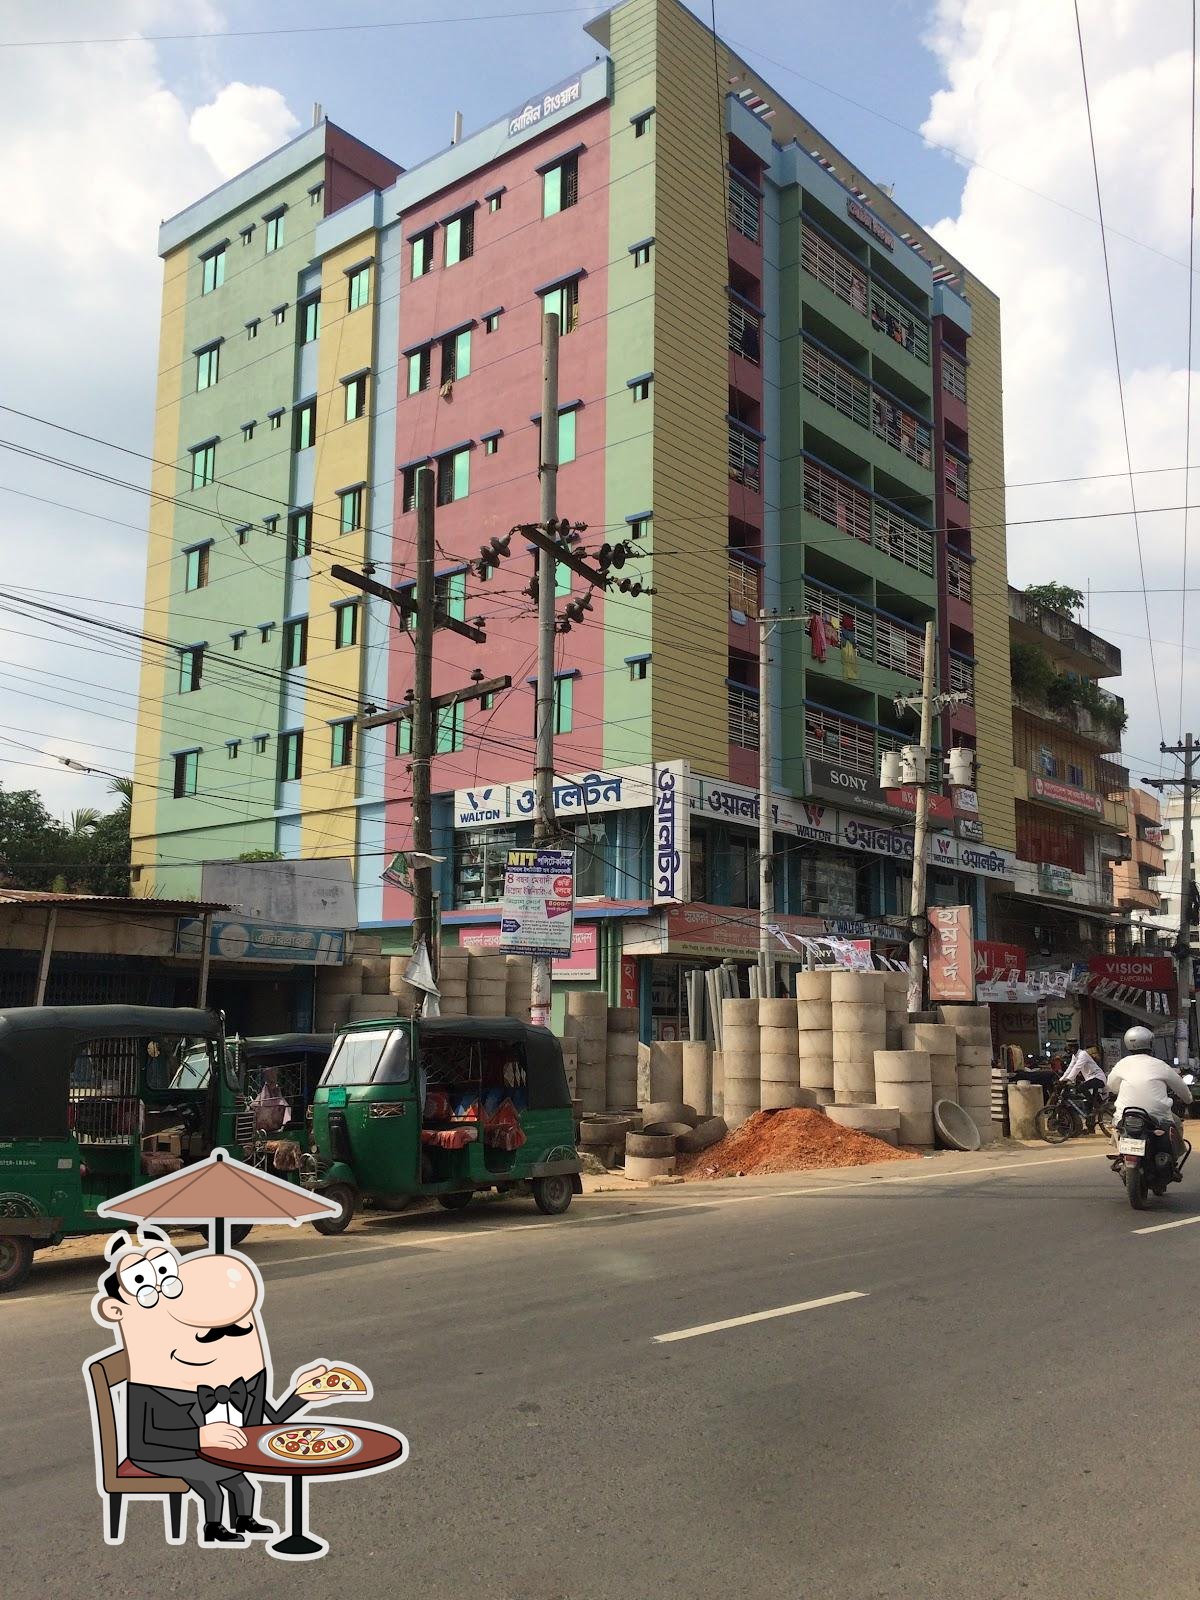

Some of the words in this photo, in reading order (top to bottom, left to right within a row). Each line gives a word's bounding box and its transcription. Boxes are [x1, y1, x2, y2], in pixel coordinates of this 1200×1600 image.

[829, 770, 868, 791] SONY
[516, 773, 623, 813] ওালটন
[460, 809, 500, 824] WALTON
[656, 768, 681, 897] ওয়ালটন
[795, 823, 832, 842] WALTON
[508, 851, 537, 866] NIT
[961, 849, 1006, 874] ওয়ালটন
[1105, 962, 1153, 975] VISION
[1120, 975, 1153, 983] EMPORIUM
